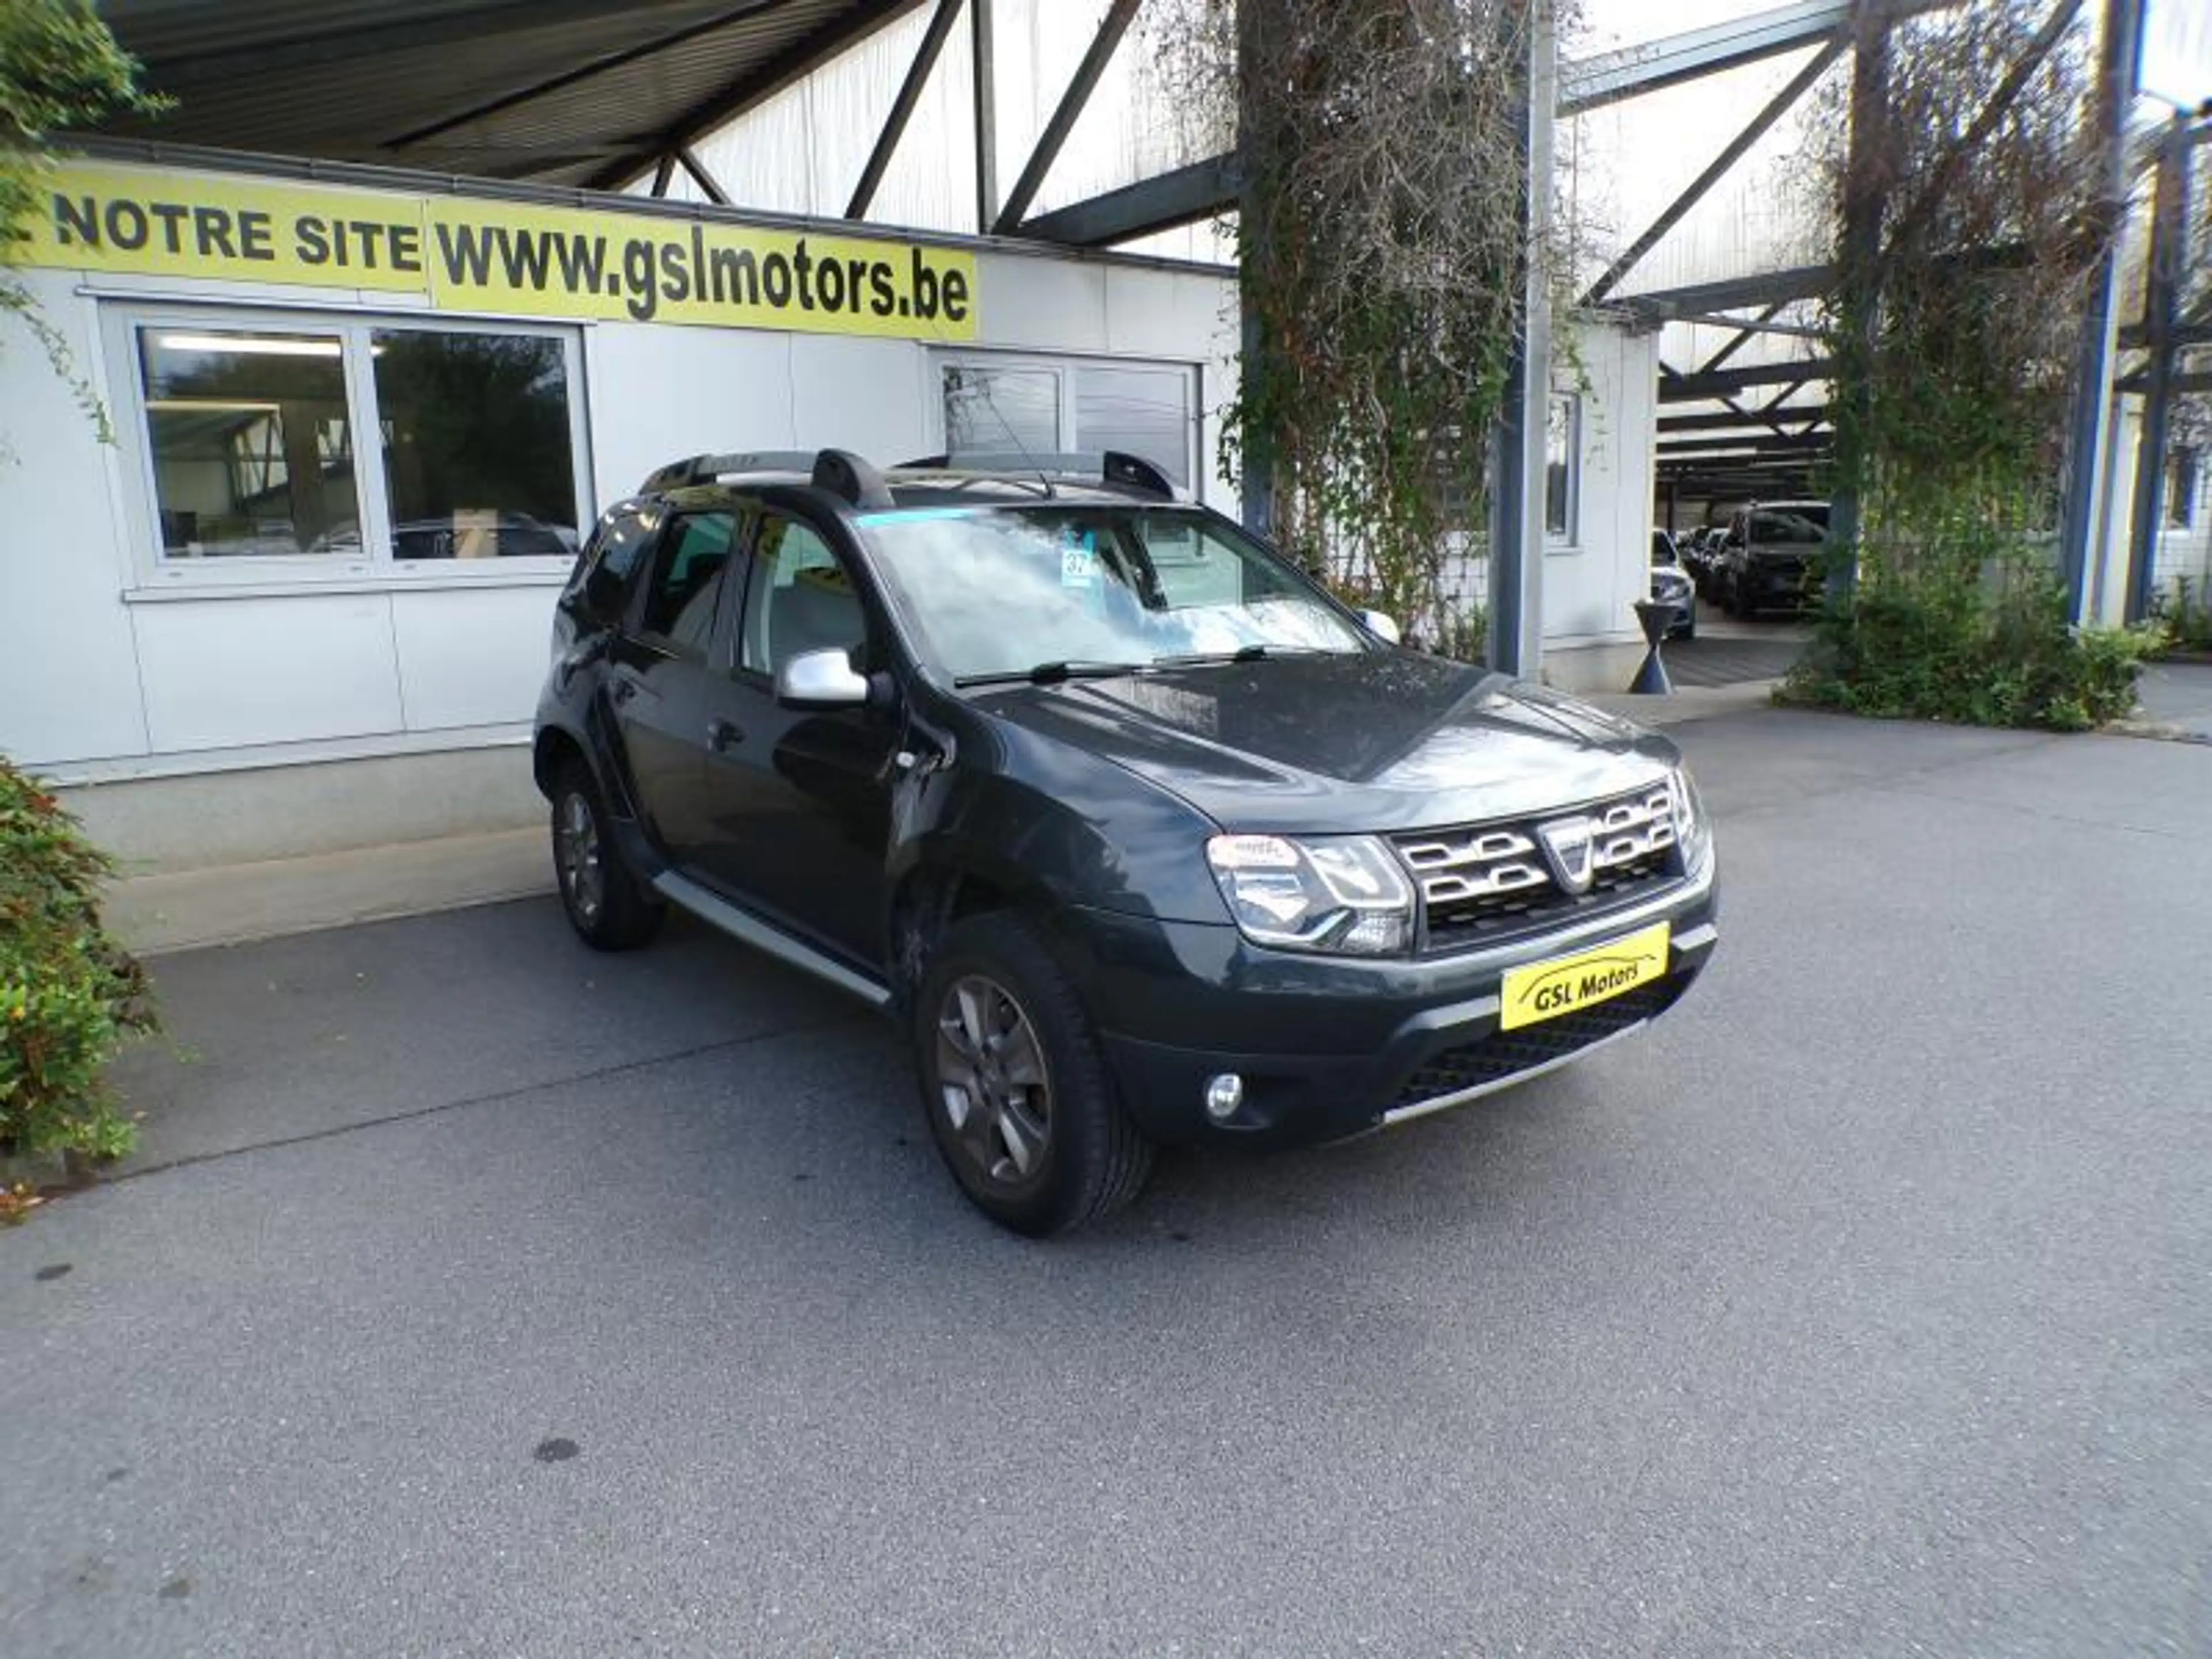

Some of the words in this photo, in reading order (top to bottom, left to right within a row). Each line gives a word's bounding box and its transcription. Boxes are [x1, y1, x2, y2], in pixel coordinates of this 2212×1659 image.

[53, 193, 274, 261] NOTRE
[294, 216, 422, 271] SITE
[1535, 984, 1572, 1011] GSL
[1578, 964, 1639, 1000] Motors
